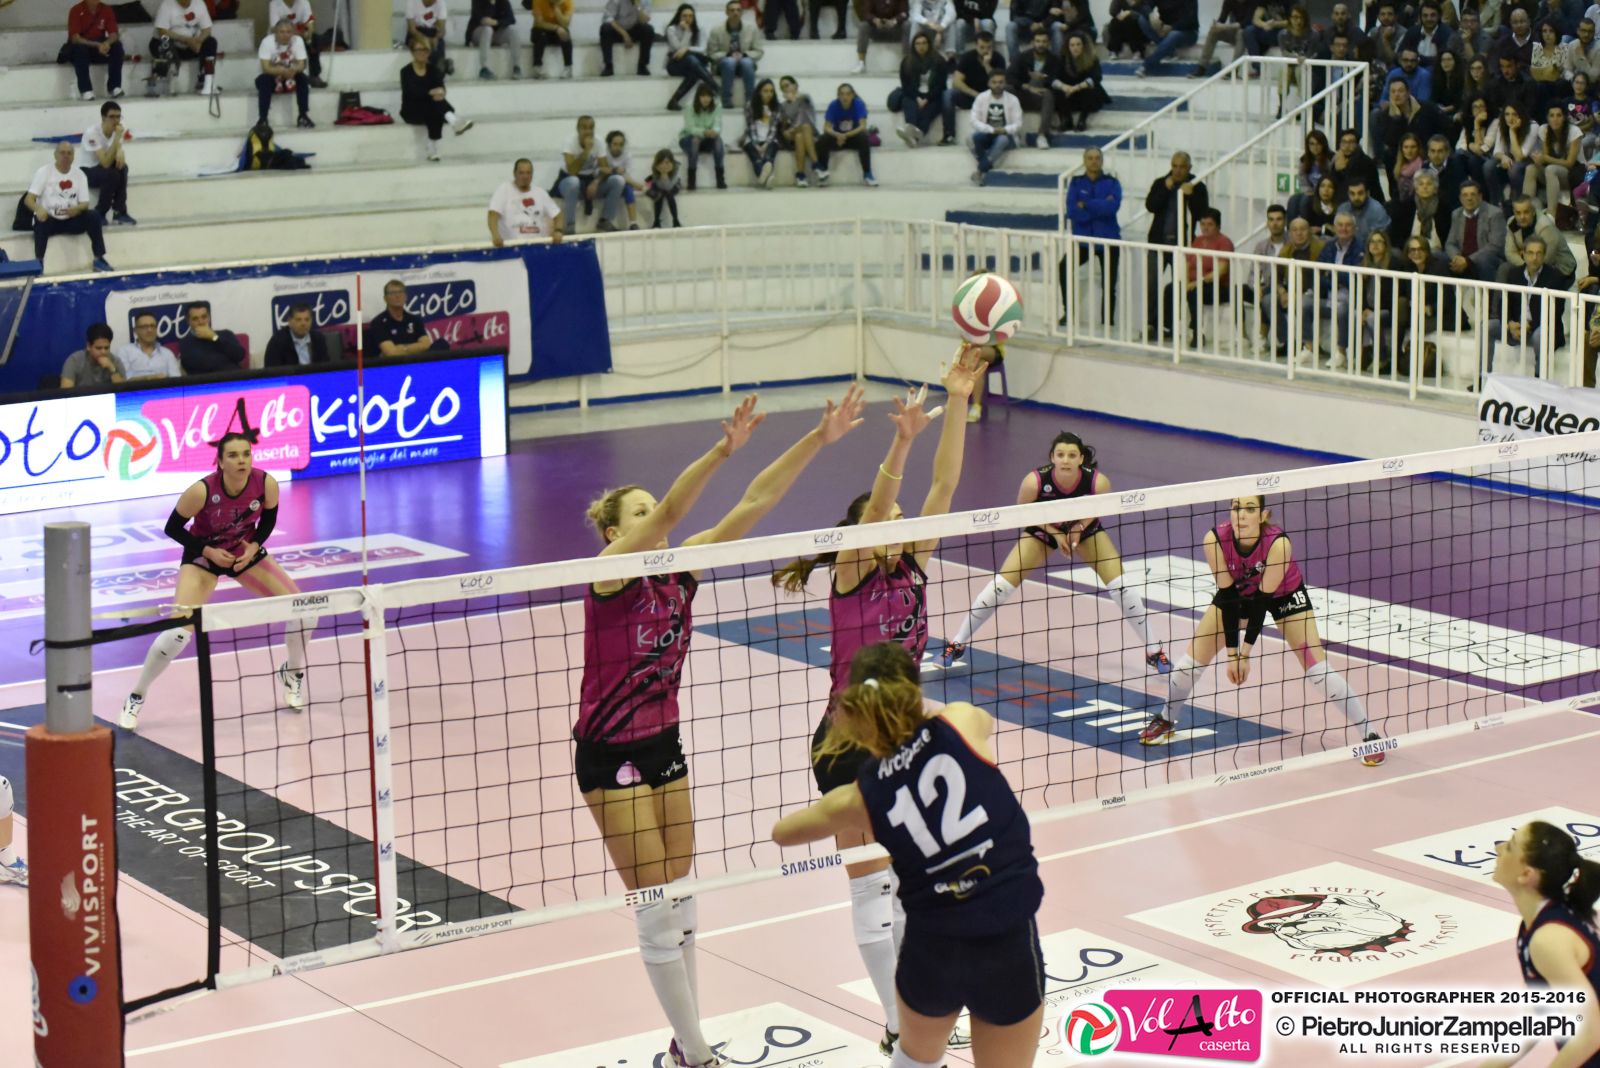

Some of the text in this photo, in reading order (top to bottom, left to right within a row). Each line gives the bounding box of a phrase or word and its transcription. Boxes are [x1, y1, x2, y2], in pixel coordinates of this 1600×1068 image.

[250, 443, 300, 463] aserta
[292, 595, 329, 607] molten
[1292, 590, 1307, 605] 15
[1352, 738, 1398, 758] SAMSUNG
[1229, 765, 1283, 782] MASTER GROUP SPORT
[886, 753, 990, 859] 12
[1101, 795, 1126, 805] molten
[116, 810, 155, 829] THE
[141, 827, 190, 845] ART
[781, 853, 843, 877] SAMSUNG
[81, 813, 101, 977] VIVISPORT
[294, 873, 453, 934] SPOR
[639, 887, 665, 903] TIM
[435, 918, 513, 939] MASTER GROUP SPORT
[1391, 948, 1419, 959] DI
